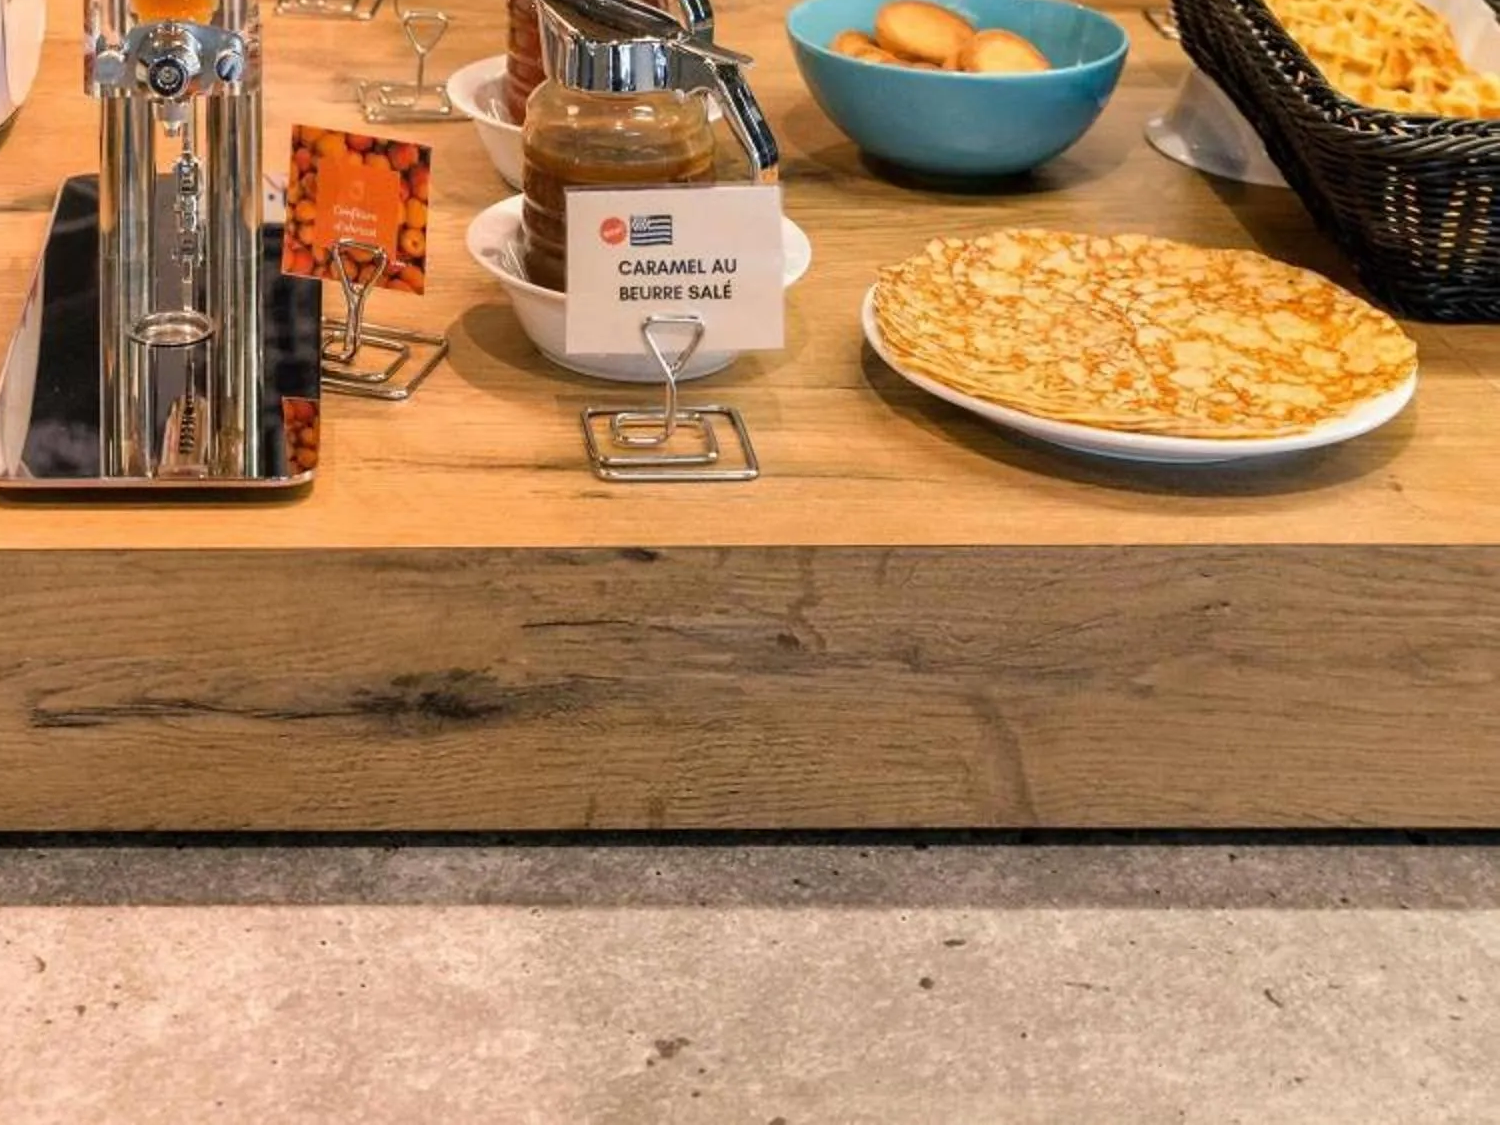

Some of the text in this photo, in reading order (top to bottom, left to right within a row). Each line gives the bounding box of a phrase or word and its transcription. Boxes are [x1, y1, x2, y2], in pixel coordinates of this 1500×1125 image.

[618, 259, 738, 275] CARAMEL AU
[619, 279, 733, 301] BEURRE SALÉ
